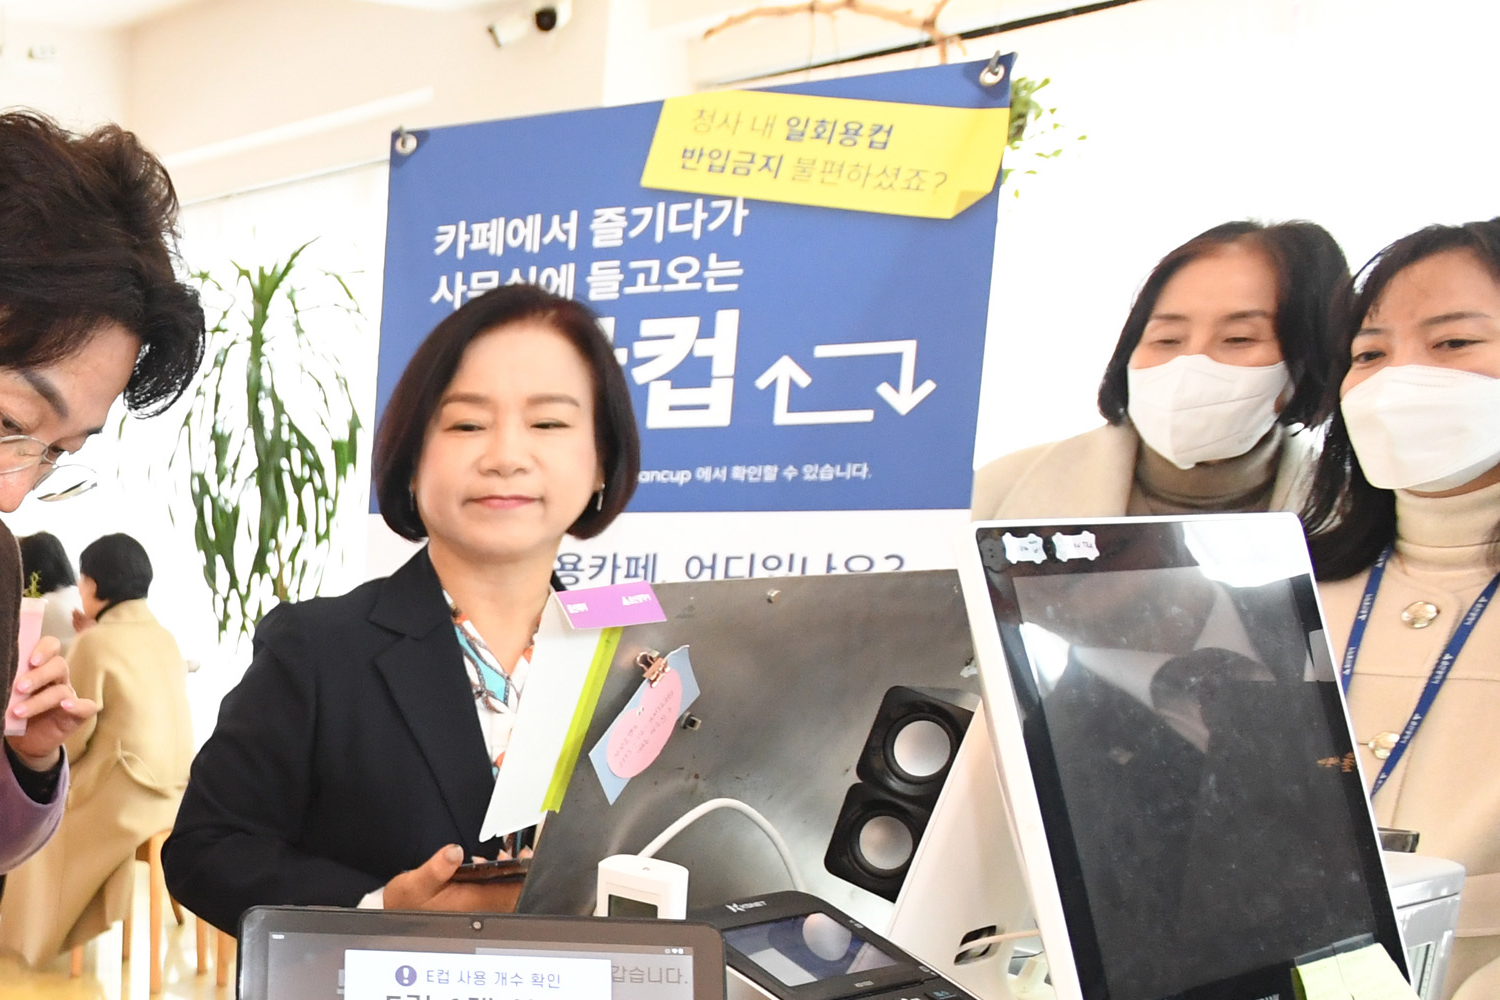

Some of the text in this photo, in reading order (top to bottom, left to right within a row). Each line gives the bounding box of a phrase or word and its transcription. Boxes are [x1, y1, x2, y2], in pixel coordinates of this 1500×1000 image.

[750, 112, 777, 139] 내
[785, 115, 895, 151] 일회용컵
[680, 146, 949, 194] 반입금지 불편하셨죠?
[433, 196, 749, 261] 카페에서 즐기다가
[586, 252, 744, 301] 들고오는
[695, 466, 728, 484] 에서
[731, 464, 778, 483] 확인할
[783, 464, 799, 482] 수
[802, 462, 873, 481] 있습니다.
[426, 968, 561, 990] E컵 사용 개수 확인
